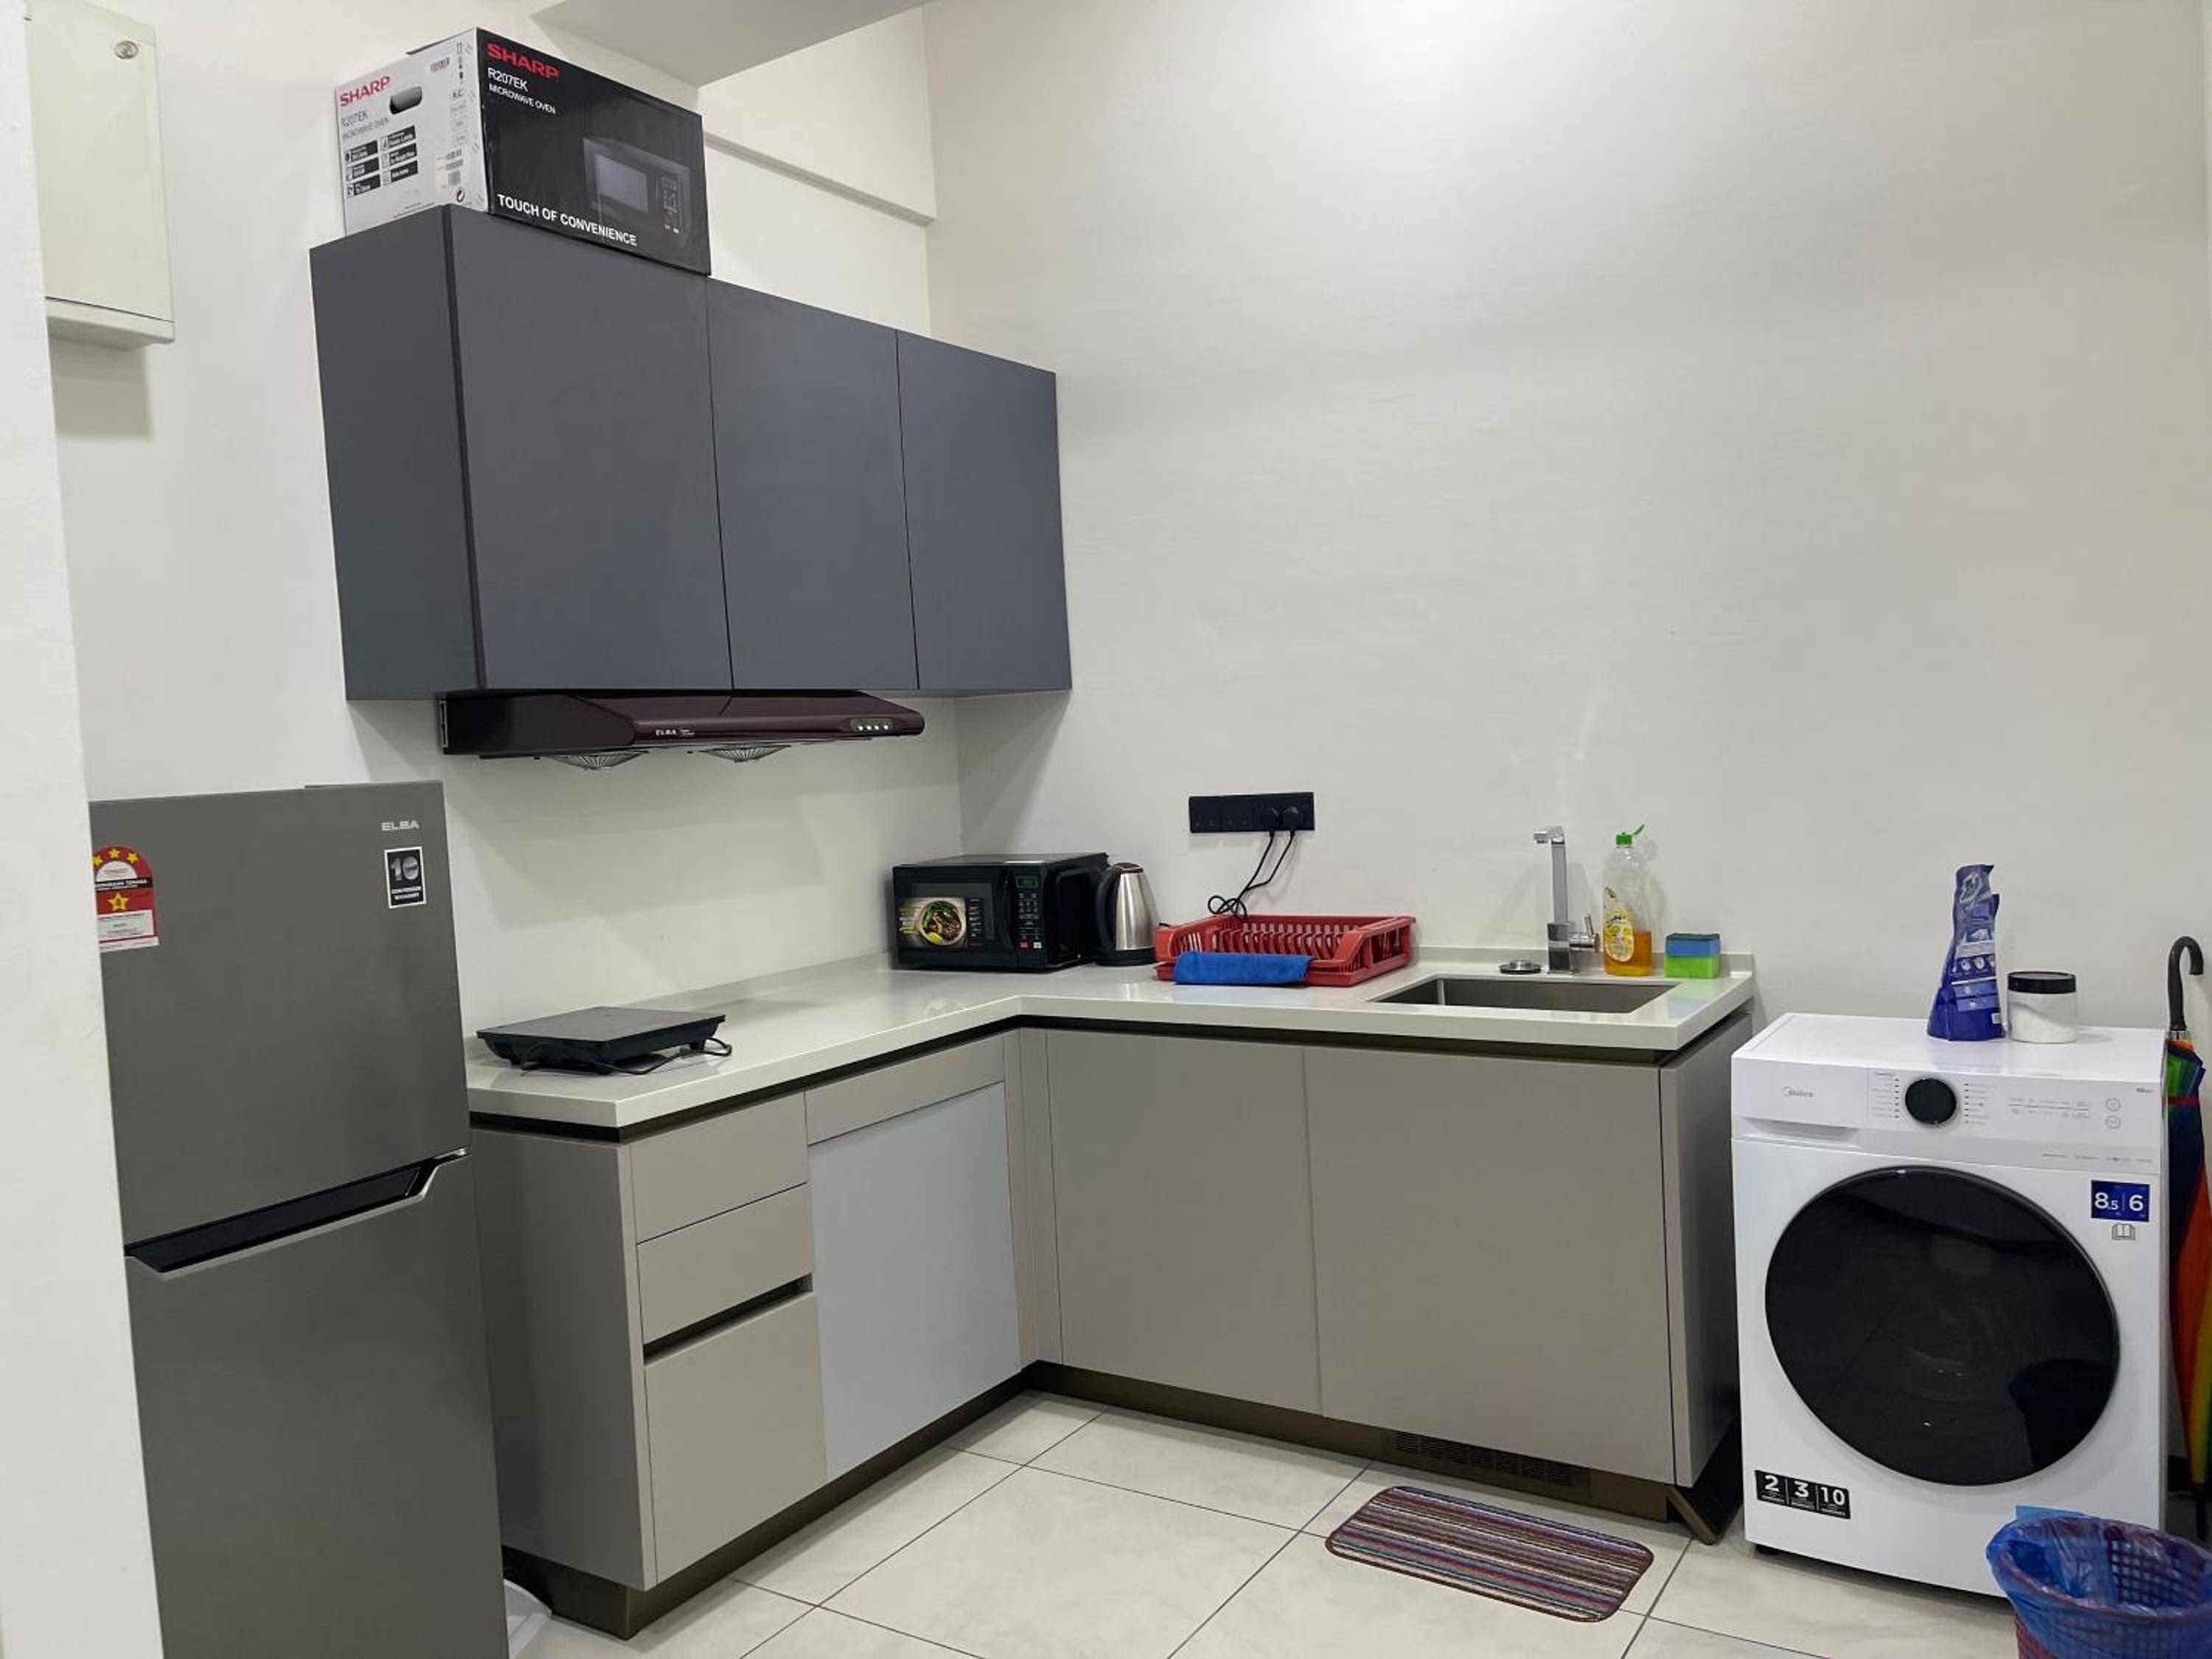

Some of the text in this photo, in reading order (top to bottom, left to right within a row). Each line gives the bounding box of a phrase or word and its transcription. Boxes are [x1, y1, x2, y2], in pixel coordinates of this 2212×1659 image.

[487, 42, 560, 80] SHARP
[340, 76, 390, 107] SHARP
[487, 67, 529, 92] R207EK
[489, 83, 534, 107] MICROWAVE
[535, 100, 556, 114] OVEN
[497, 193, 638, 246] TOUCH OF CONVENIENCE
[380, 819, 420, 832] ELBA
[391, 856, 420, 880] 10
[2128, 1194, 2144, 1211] 6
[1764, 1475, 1779, 1492] 2
[1794, 1481, 1809, 1498] 3
[1820, 1486, 1846, 1506] 10
